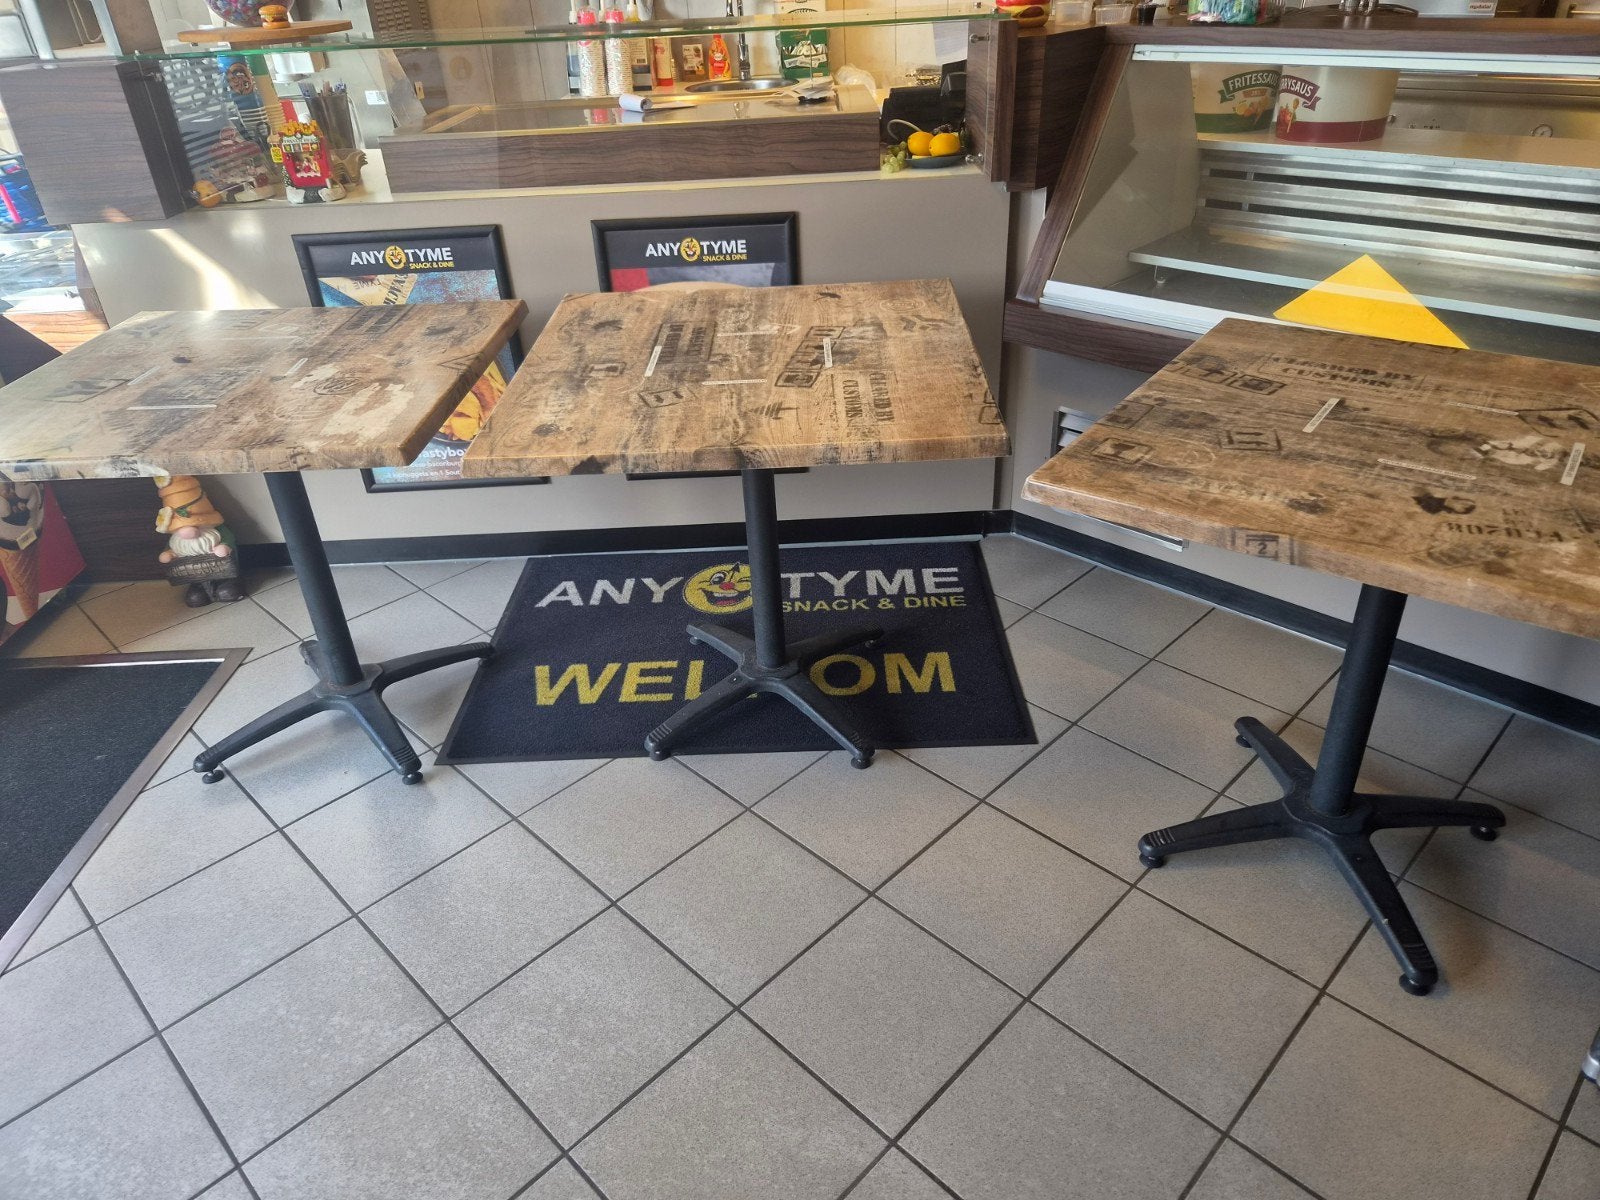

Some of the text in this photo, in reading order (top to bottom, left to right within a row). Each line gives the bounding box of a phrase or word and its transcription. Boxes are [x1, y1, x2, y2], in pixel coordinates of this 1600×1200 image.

[350, 247, 454, 266] ANY TYME
[645, 239, 747, 257] ANY TYME
[423, 446, 467, 459] astybo
[1257, 542, 1267, 554] 2
[534, 567, 964, 608] ANY TYME
[782, 595, 967, 613] SNACK & DINE
[534, 652, 956, 706] WELOM
